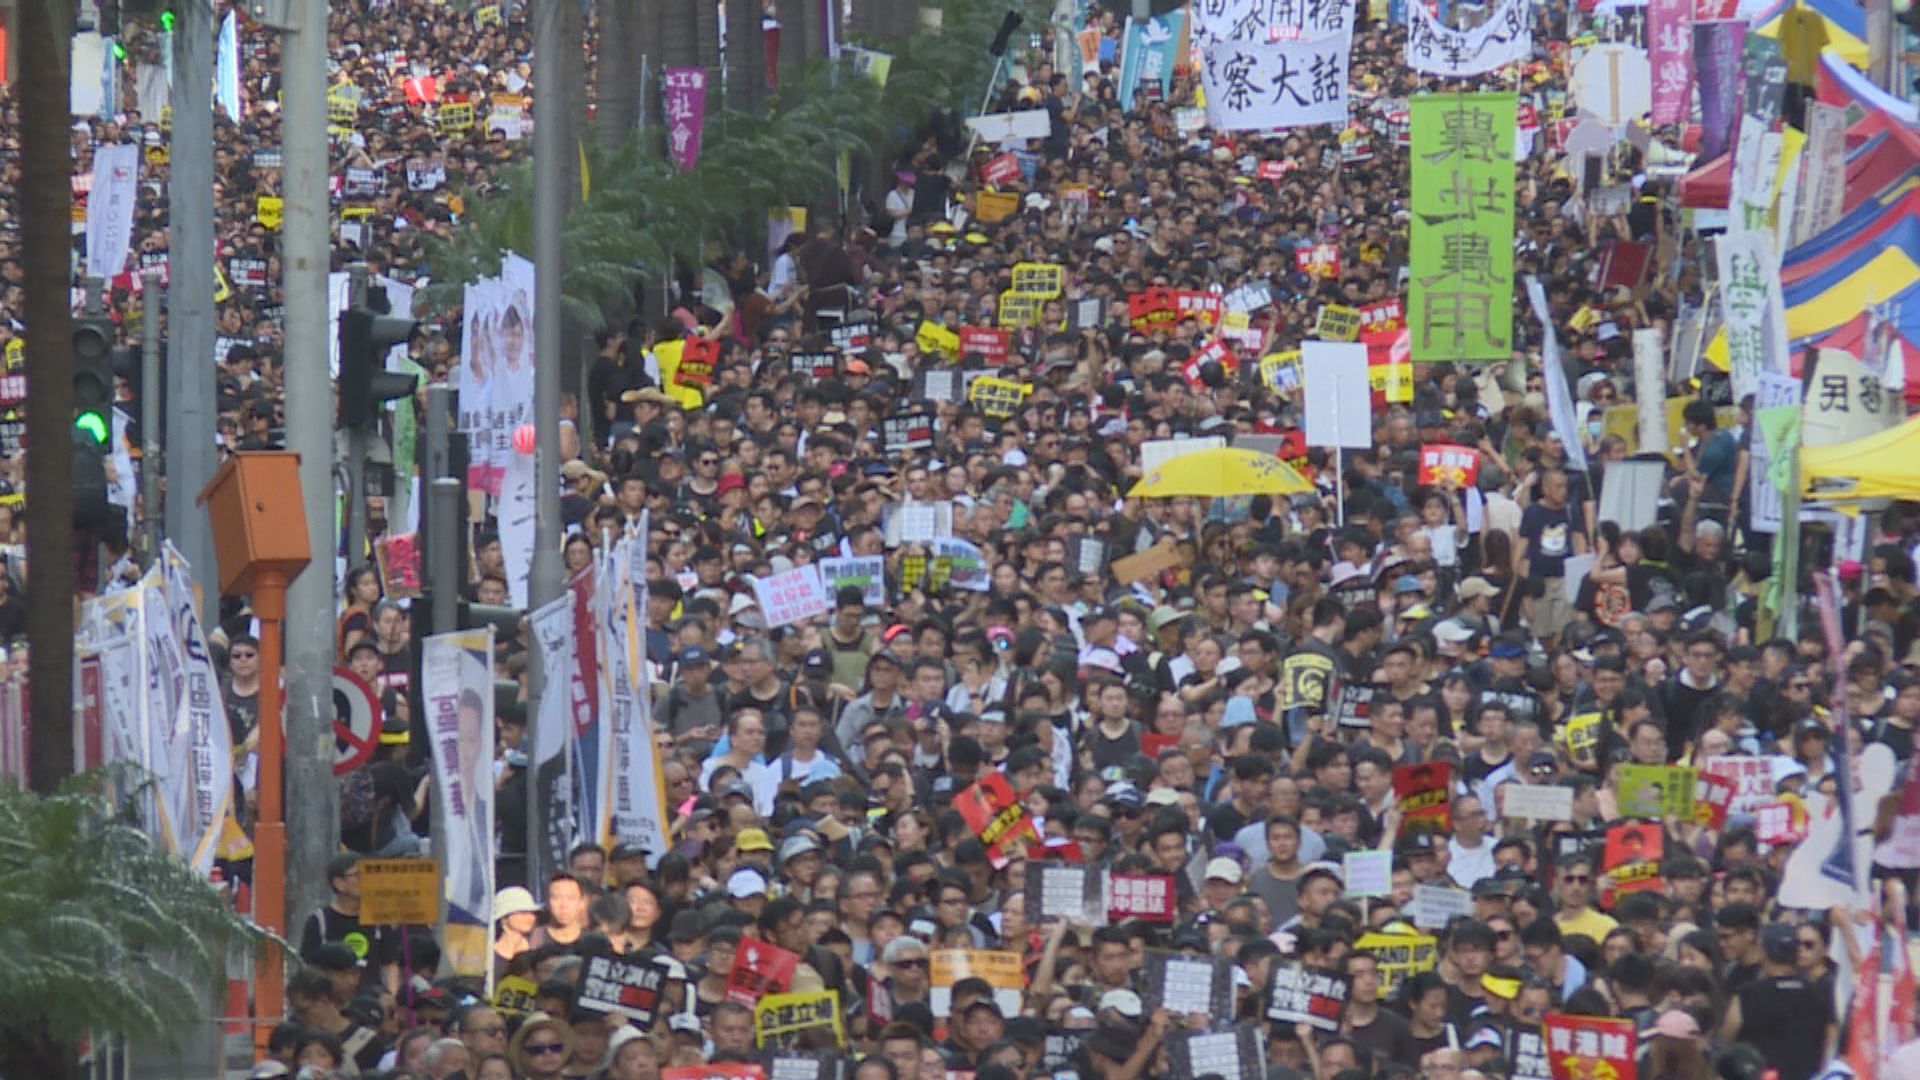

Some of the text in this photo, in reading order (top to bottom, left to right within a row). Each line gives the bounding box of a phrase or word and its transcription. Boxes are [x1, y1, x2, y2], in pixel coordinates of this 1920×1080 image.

[1109, 895, 1166, 914] 中惡法
[589, 954, 661, 992] 獨立調查
[1275, 963, 1347, 1000] 獨立調查
[762, 998, 833, 1029] 企硬立場
